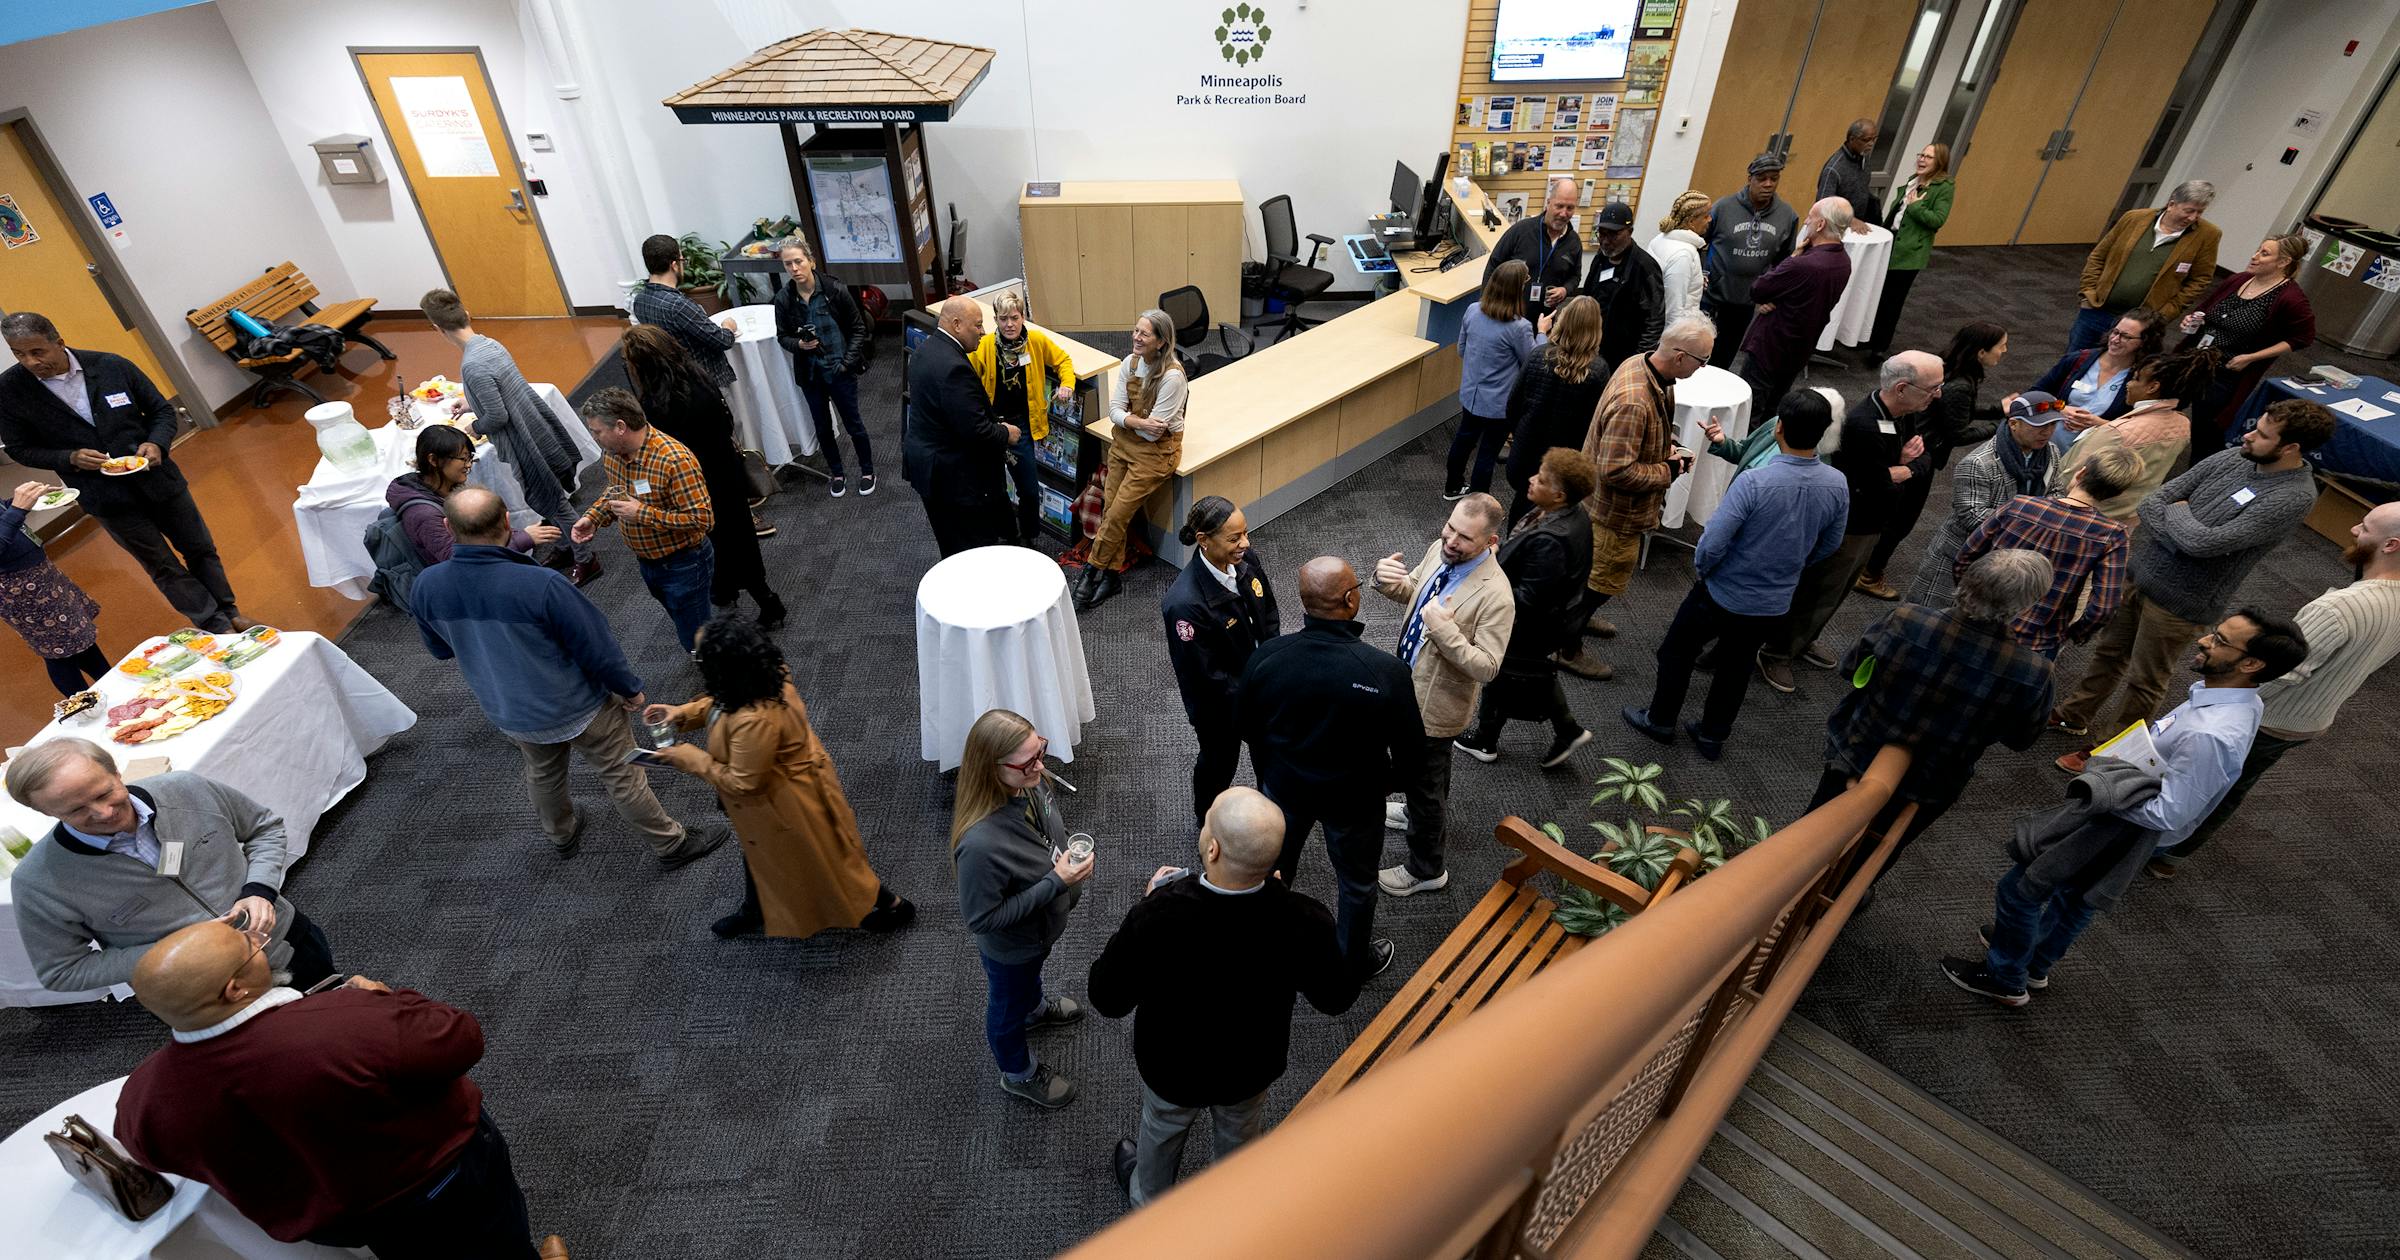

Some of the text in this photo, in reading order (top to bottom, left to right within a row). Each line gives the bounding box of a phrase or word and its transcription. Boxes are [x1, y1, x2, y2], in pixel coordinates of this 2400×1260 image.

[1200, 74, 1283, 90] Minneapolis
[1176, 94, 1306, 105] Park & Recreation Board
[1596, 96, 1614, 104] JOIN
[711, 110, 915, 121] MINNEAPOLIS PARK & RECREATION BOARD
[1733, 248, 1769, 257] BULLDOGS
[195, 294, 241, 322] MINNEAPOLIS
[1352, 682, 1379, 694] SPYDER
